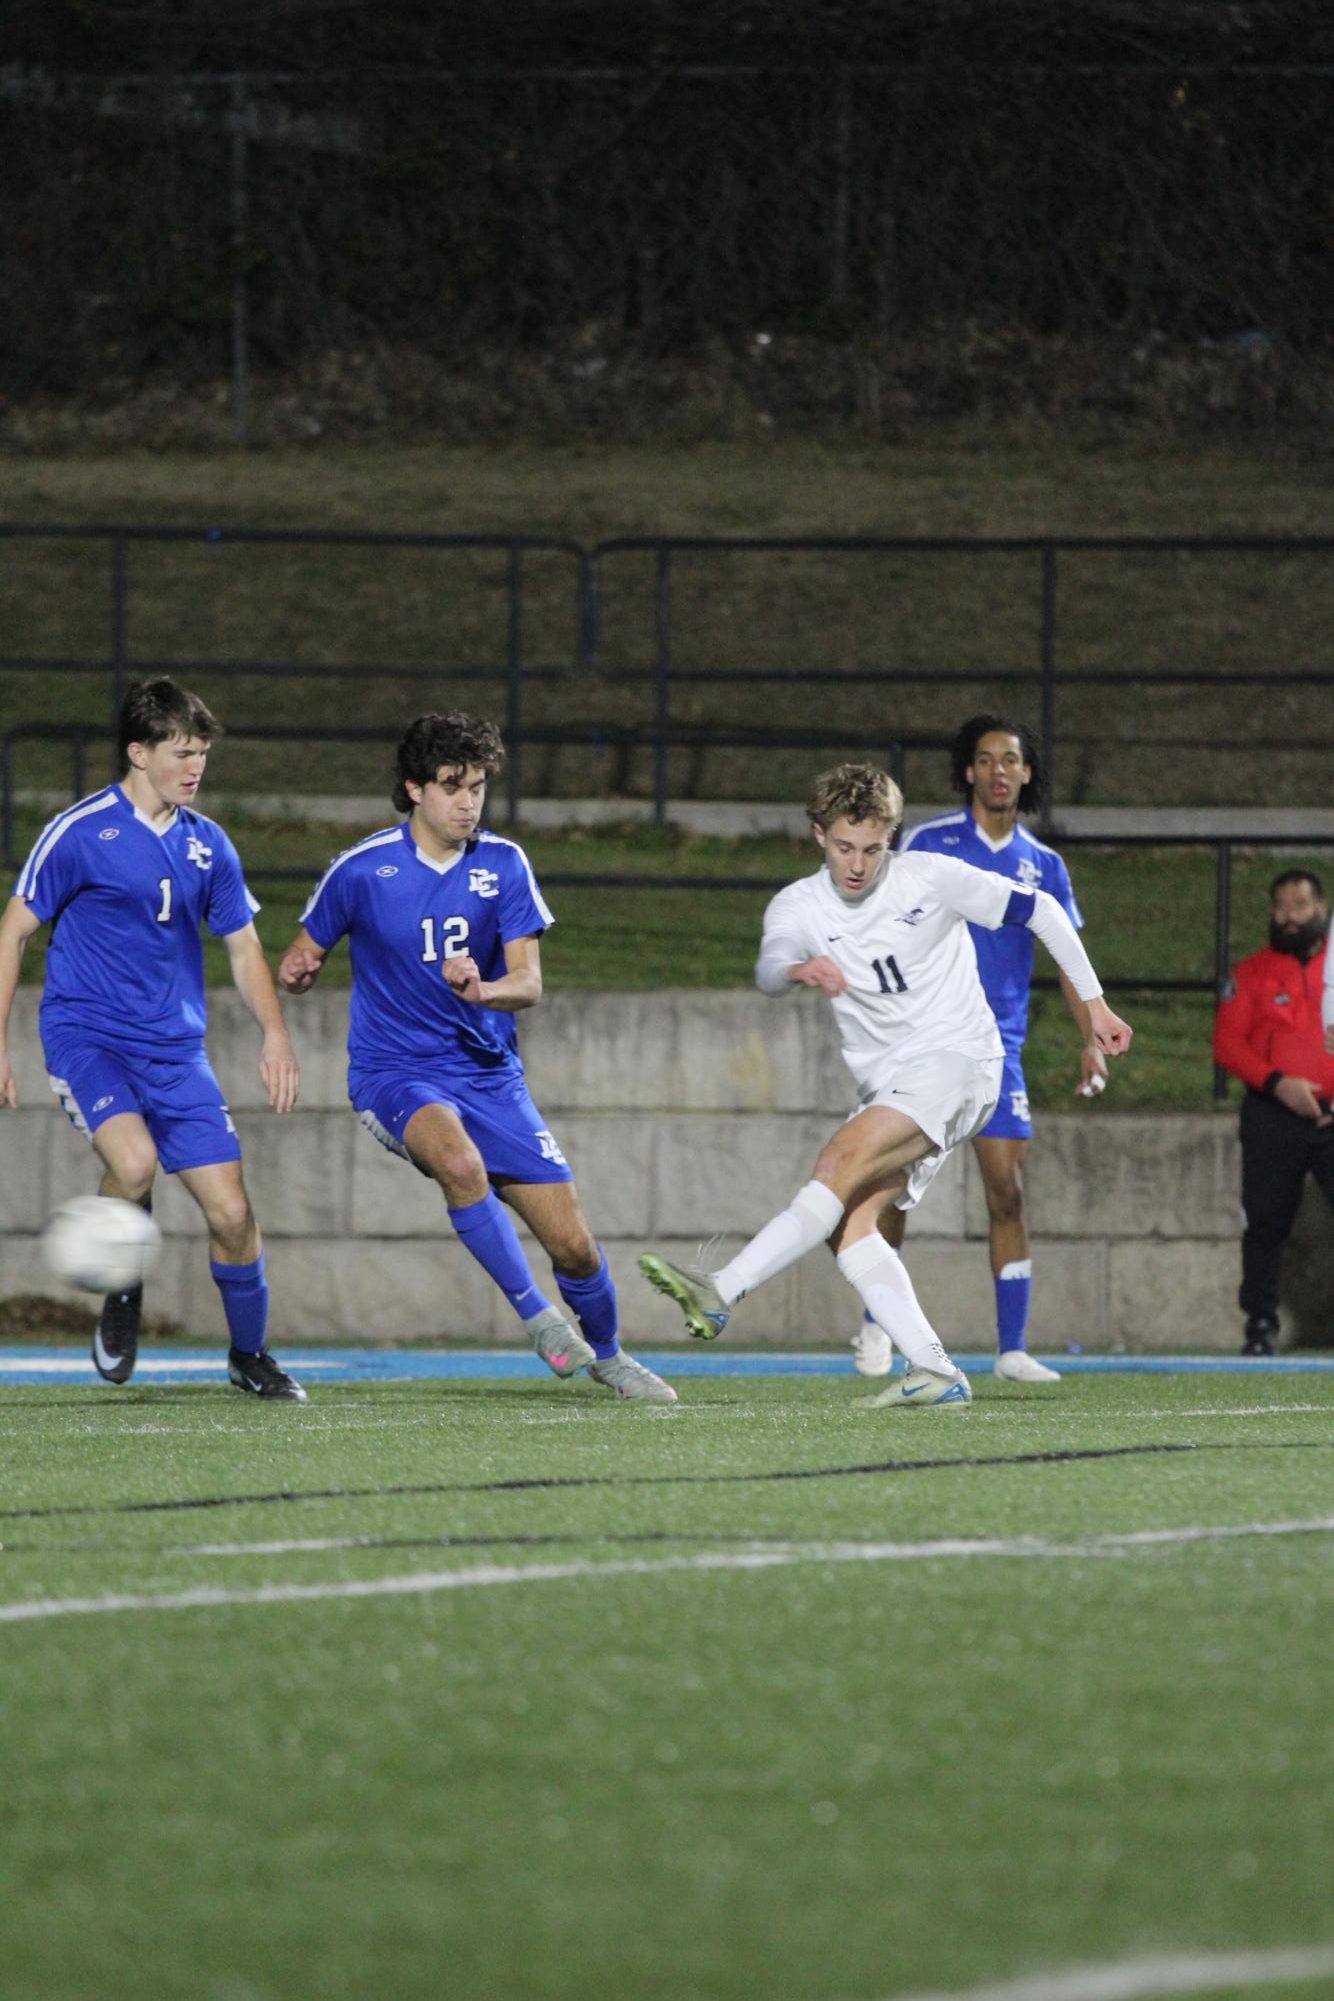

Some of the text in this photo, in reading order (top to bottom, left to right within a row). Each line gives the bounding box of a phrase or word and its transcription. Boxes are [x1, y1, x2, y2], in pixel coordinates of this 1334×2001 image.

[156, 876, 173, 922] 1
[420, 915, 470, 962] 12
[871, 954, 909, 994] 11
